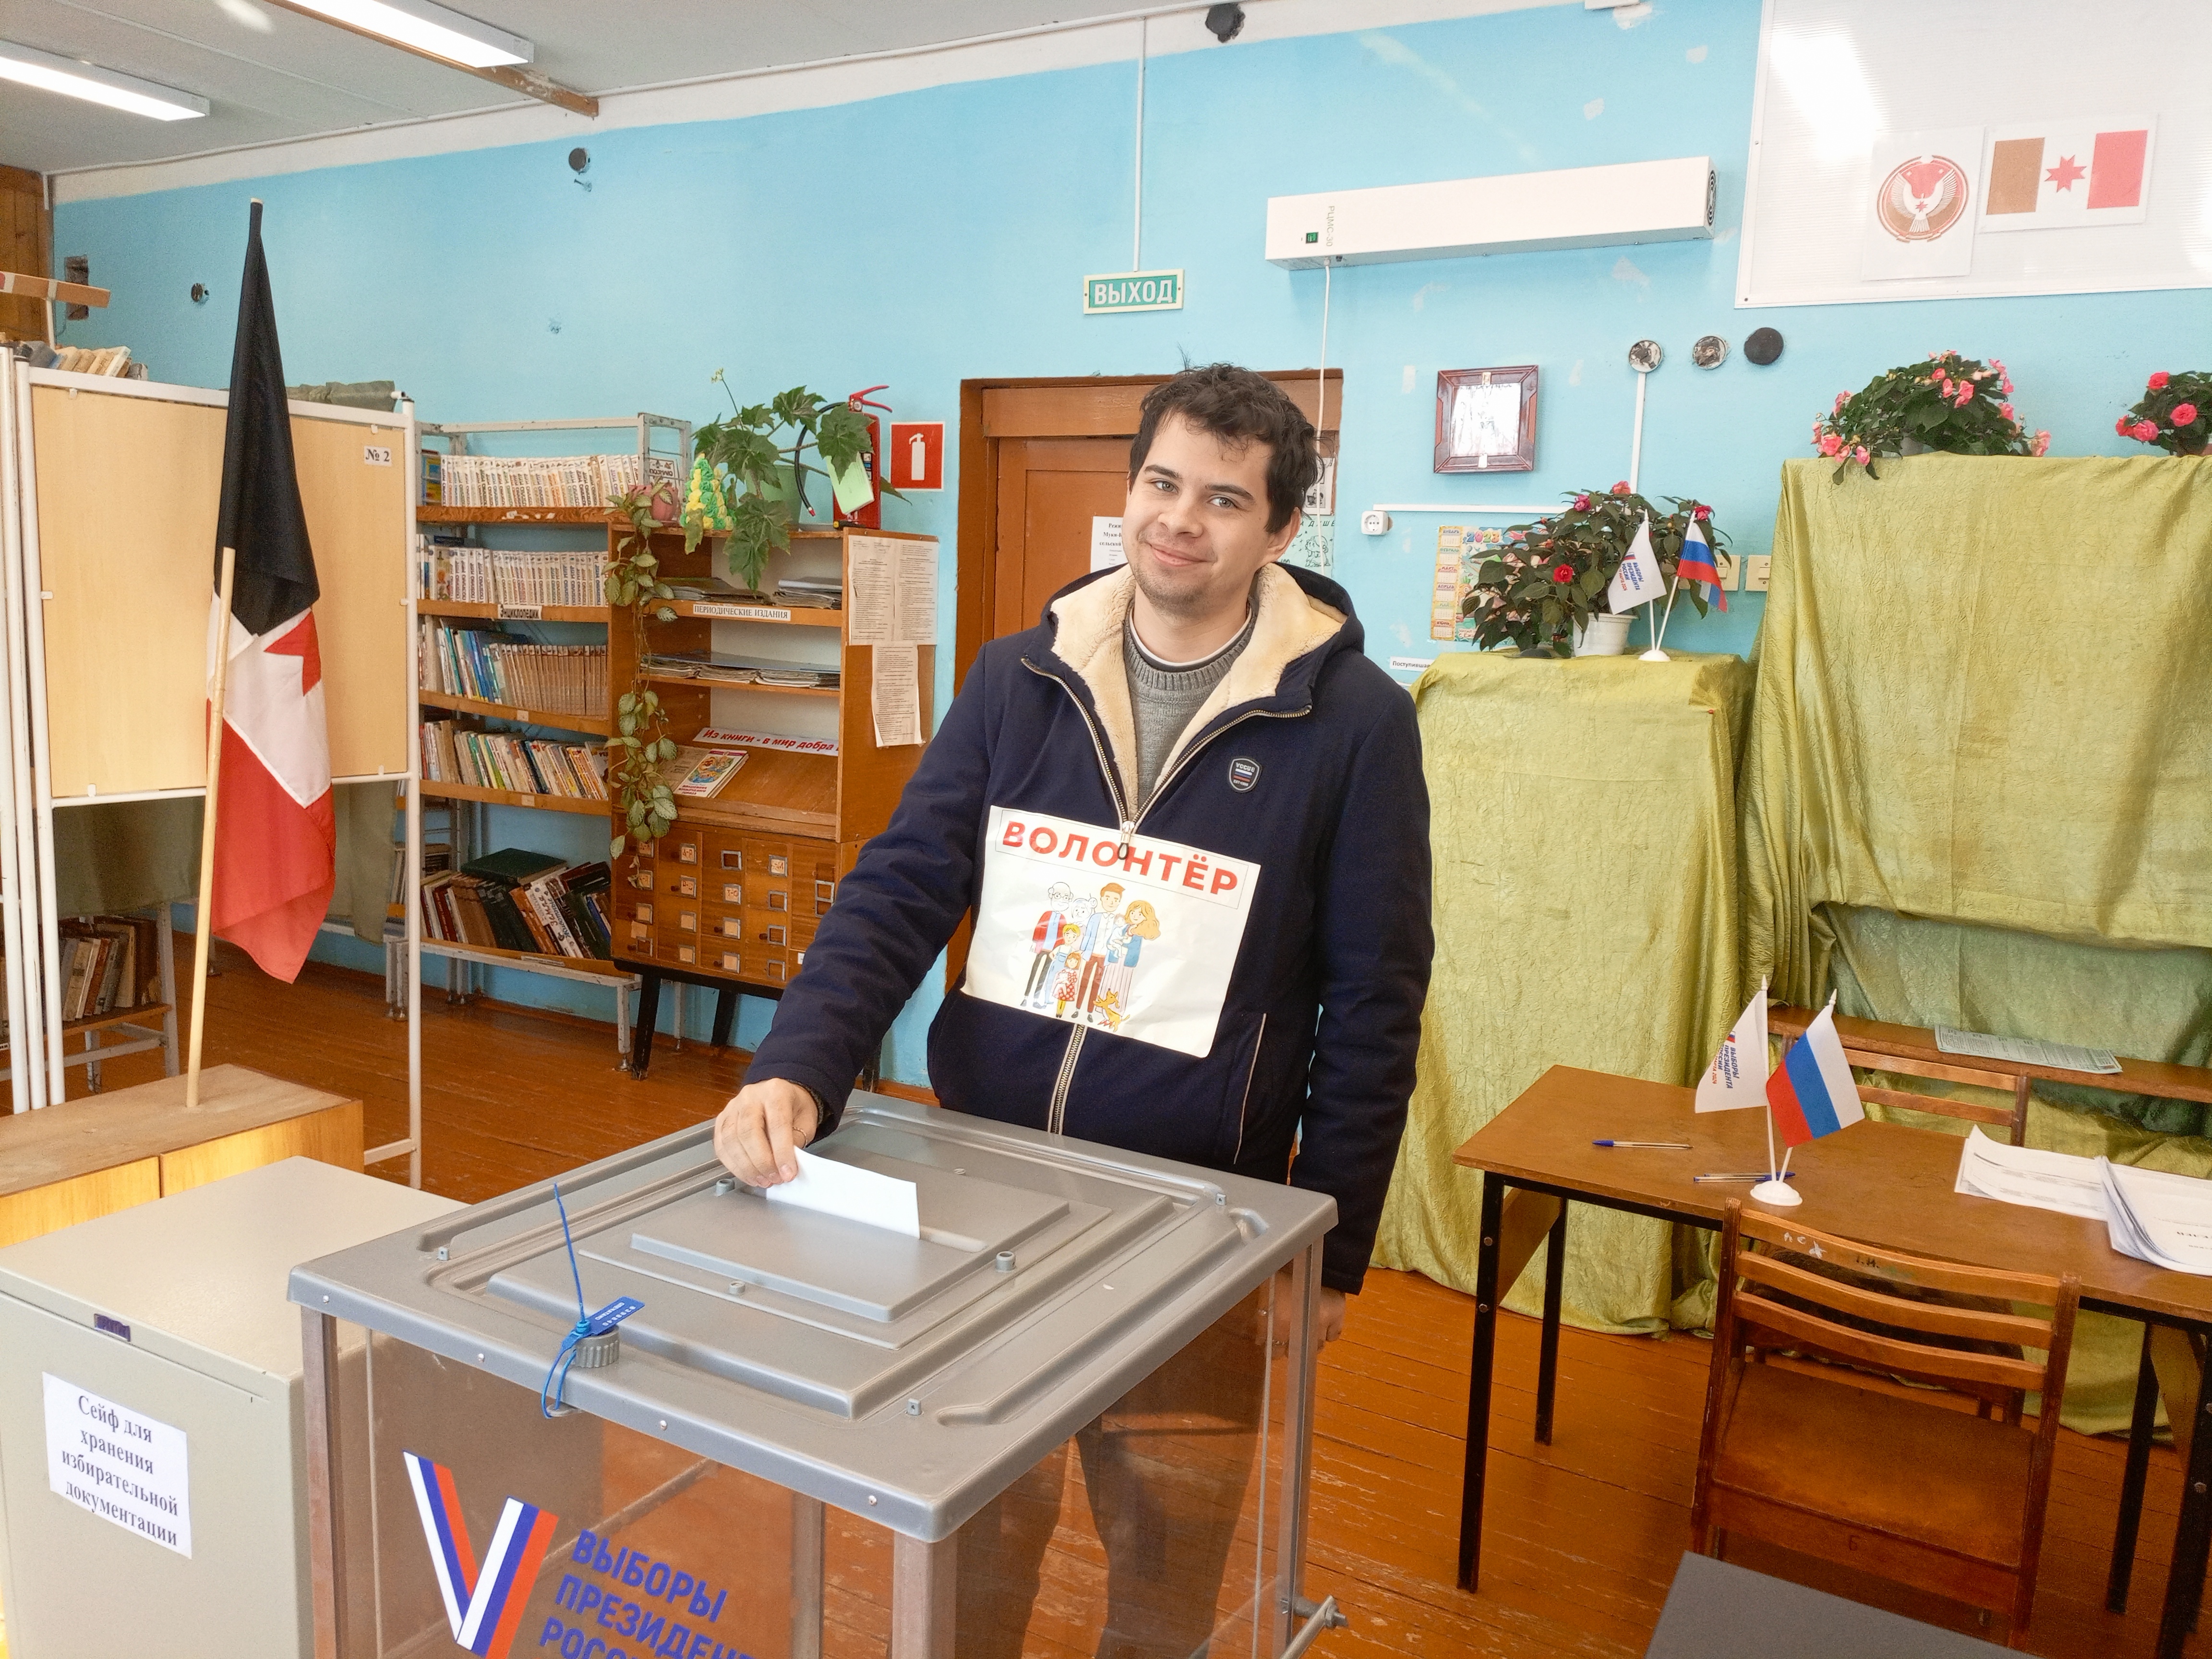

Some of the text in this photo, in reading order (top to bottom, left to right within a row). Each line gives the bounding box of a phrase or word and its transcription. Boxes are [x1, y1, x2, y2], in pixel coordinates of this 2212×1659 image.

[1094, 279, 1173, 305] ВЫХОД
[365, 448, 390, 462] № 2
[1467, 530, 1500, 543] 2023
[1622, 564, 1630, 580] РОССИИ
[1626, 563, 1640, 590] ПРЕЗИДЕНТА
[1633, 562, 1644, 582] ВЫБОРЫ
[694, 605, 788, 619] ПЕРИОДИЧЕСКИЕ ИЗДАНИЯ
[703, 730, 719, 738] Из
[720, 733, 755, 743] книги
[796, 741, 834, 753] добра
[1236, 762, 1255, 772] VOGUE
[1002, 820, 1238, 895] ВОЛОНТЁР
[548, 898, 571, 938] Животные
[1724, 1045, 1733, 1089] ПРЕЗИДЕНТА
[1730, 1047, 1740, 1079] ВЫБОРЫ
[78, 1395, 152, 1443] Сейф для
[80, 1430, 154, 1475] хранения
[62, 1450, 178, 1516] избирательной
[66, 1481, 177, 1546] документации
[572, 1528, 728, 1623] ВЫБОРЫ
